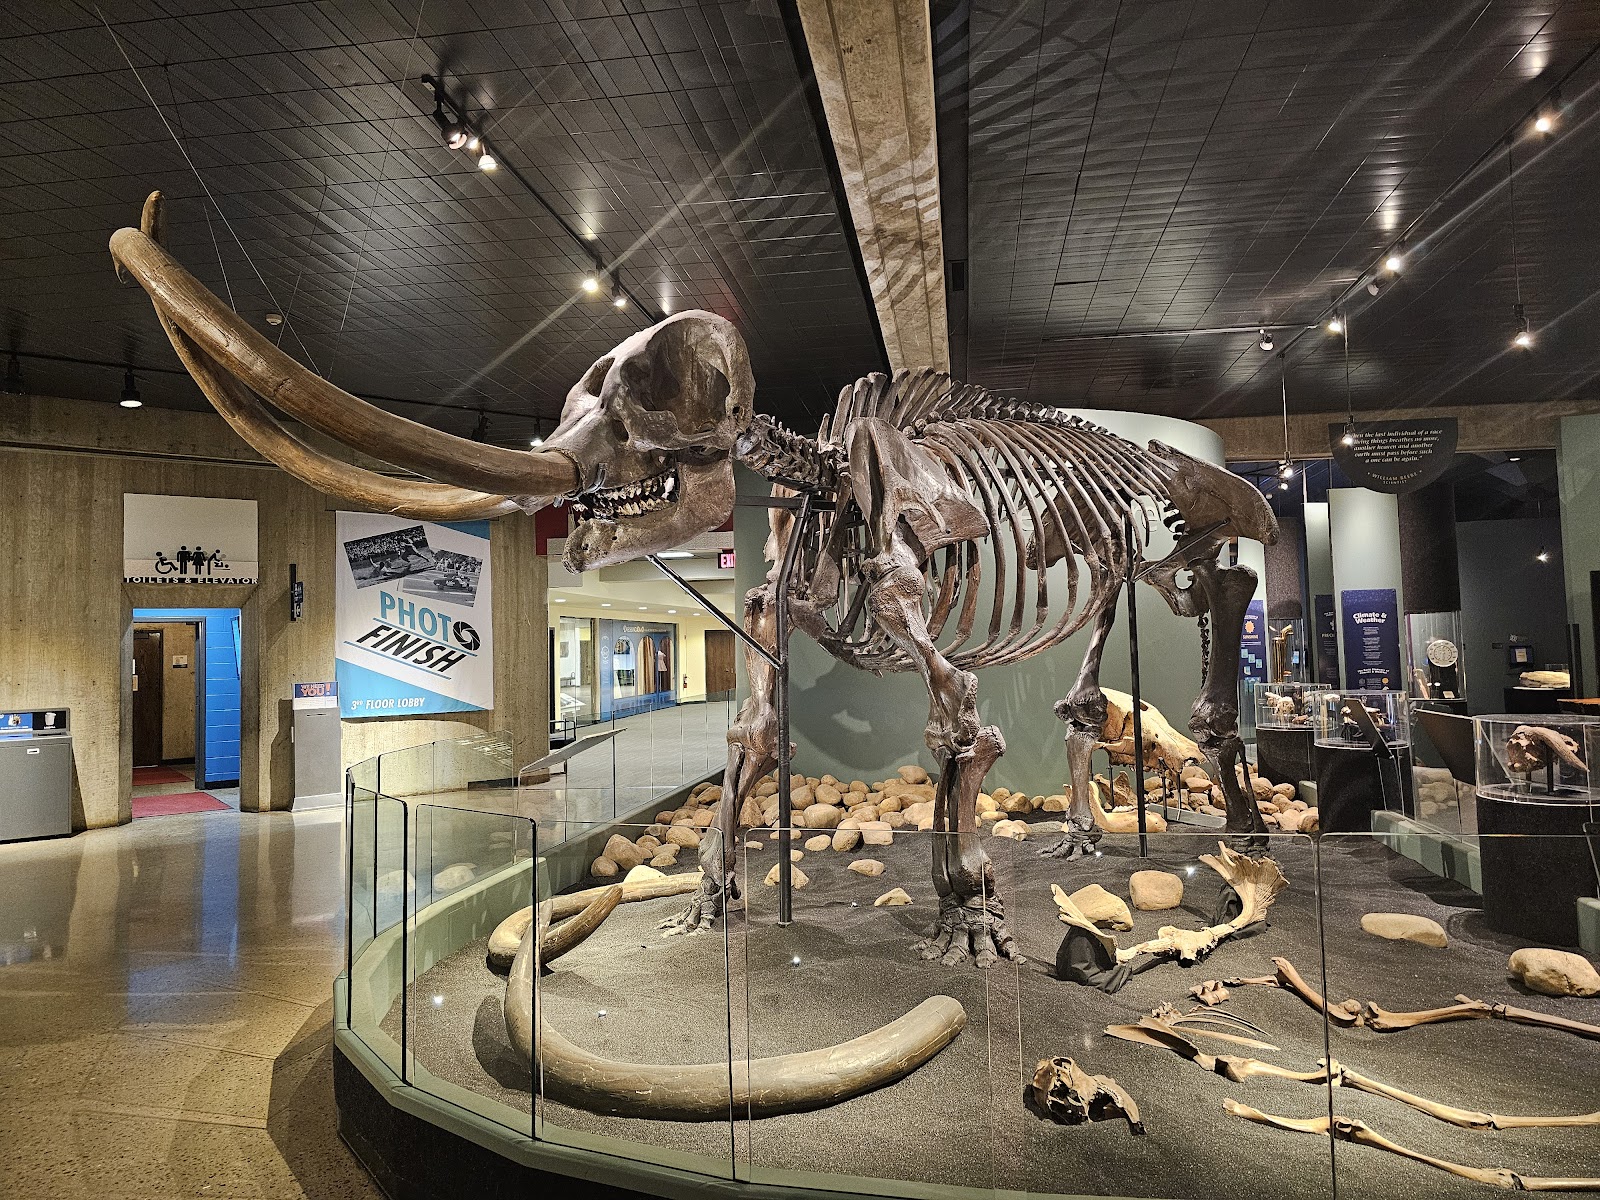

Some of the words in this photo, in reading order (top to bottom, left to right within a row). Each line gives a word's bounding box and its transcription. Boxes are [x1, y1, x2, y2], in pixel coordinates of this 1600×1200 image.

[1417, 429, 1424, 437] of
[1372, 472, 1398, 481] WILLIAM
[720, 553, 735, 568] EXI
[198, 577, 258, 585] ELEVATOR
[1353, 611, 1380, 619] Climate
[356, 624, 468, 673] FINISH
[365, 699, 395, 710] FLOOR
[397, 697, 426, 708] LOBBY
